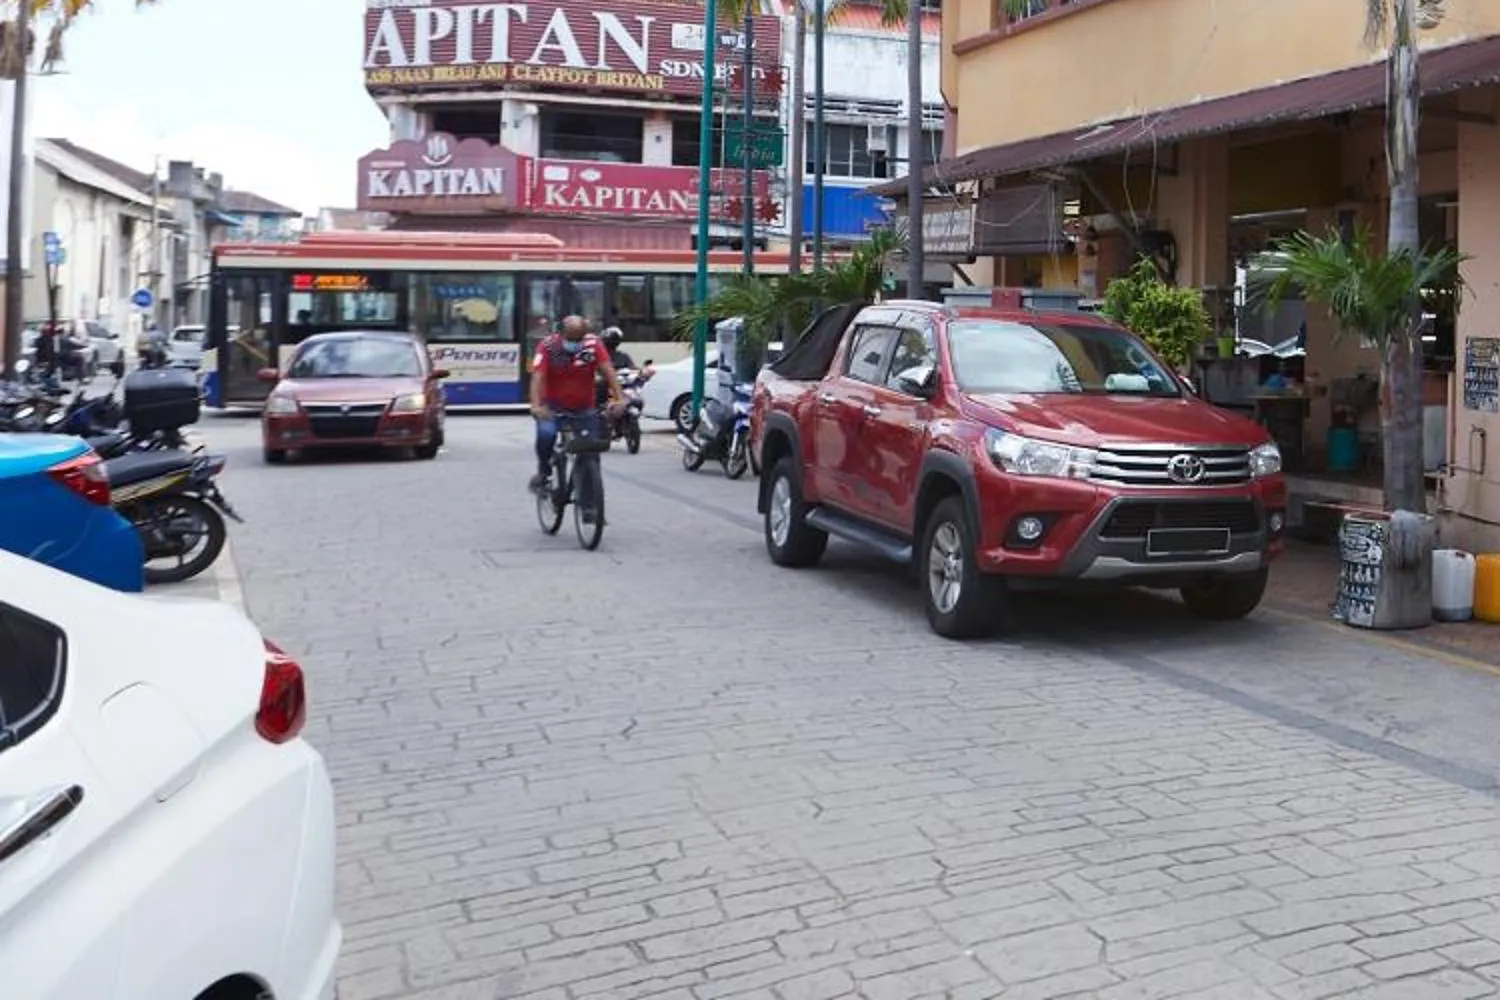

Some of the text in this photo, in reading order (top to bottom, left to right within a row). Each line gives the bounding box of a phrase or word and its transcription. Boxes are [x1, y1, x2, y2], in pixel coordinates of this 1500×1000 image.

[364, 3, 656, 75] APITAN
[511, 64, 593, 84] CLAYPOT
[596, 71, 664, 89] BRIYANI
[367, 167, 504, 197] KAPITAN
[542, 182, 690, 211] KAPITAN
